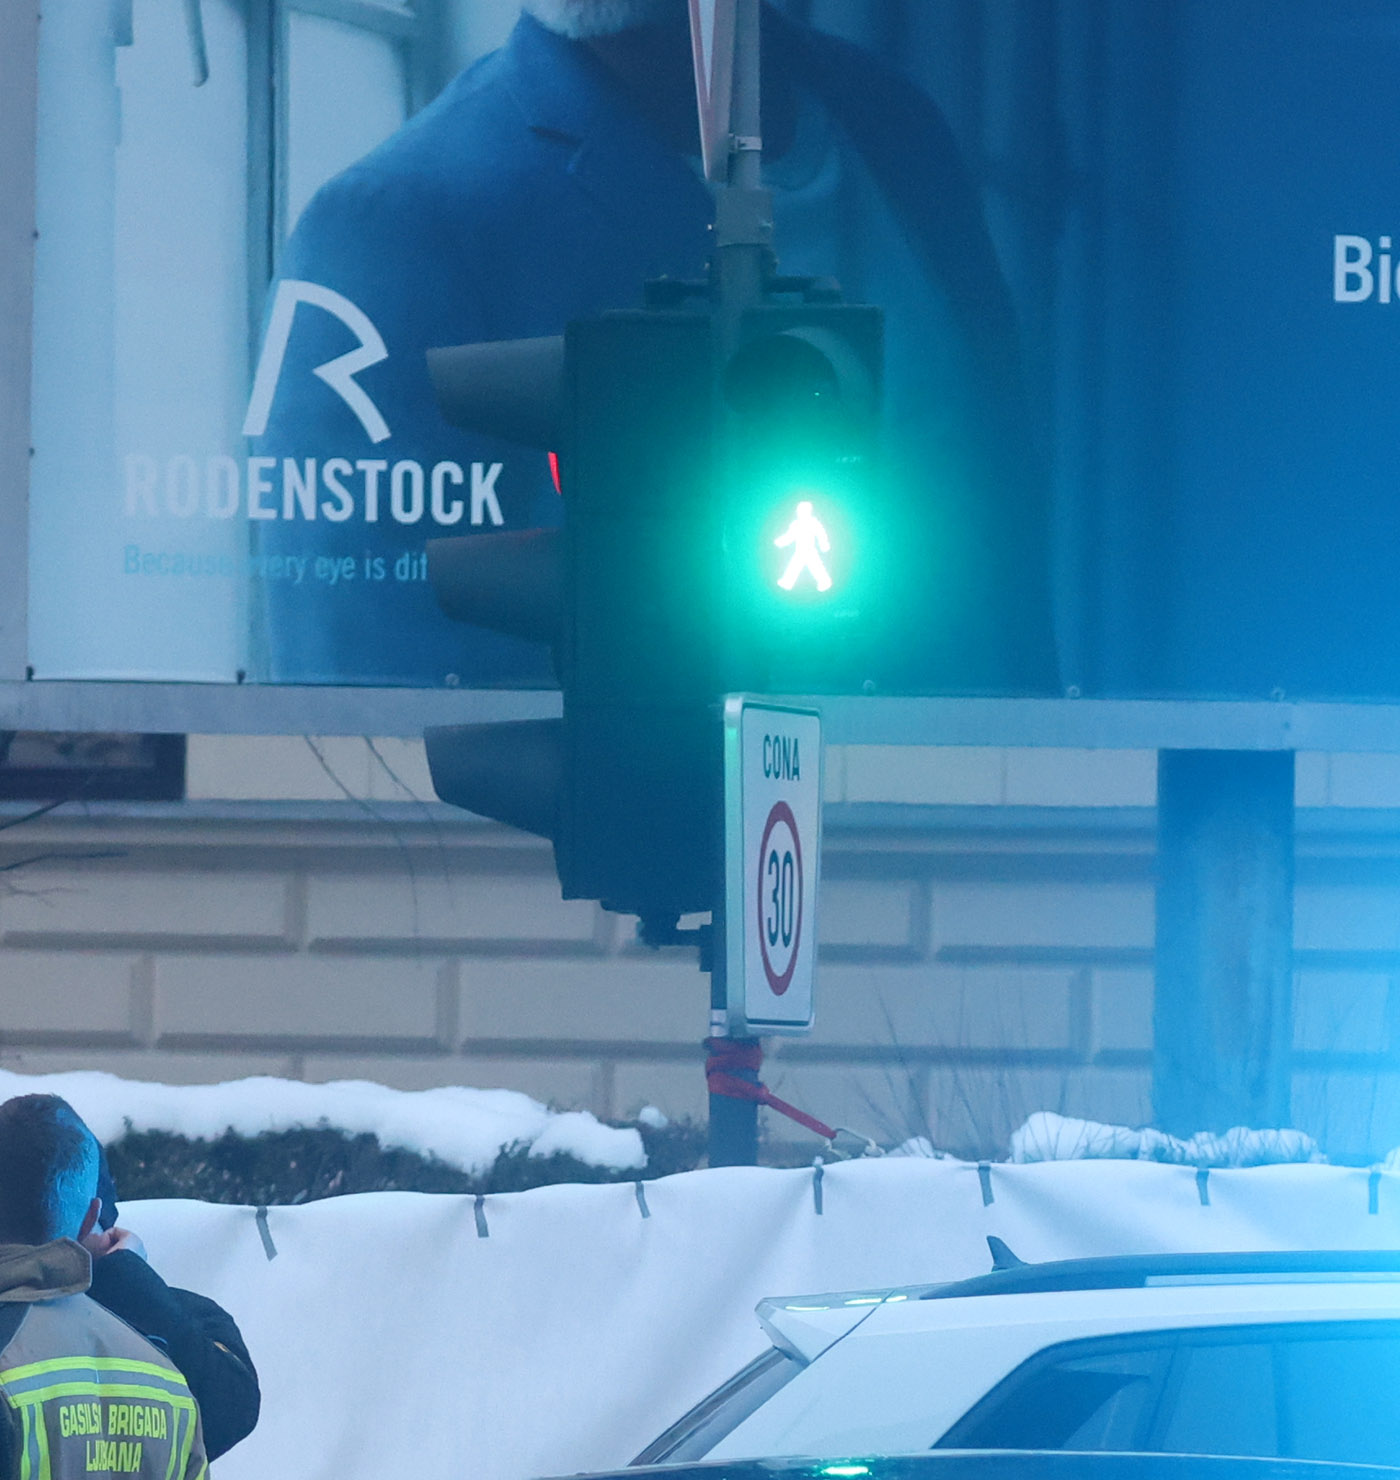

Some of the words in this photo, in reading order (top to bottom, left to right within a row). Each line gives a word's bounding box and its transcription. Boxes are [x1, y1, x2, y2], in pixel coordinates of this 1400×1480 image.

[241, 279, 392, 444] R
[124, 453, 504, 526] RODENSTOCK
[315, 556, 356, 585] eye
[365, 548, 386, 580] is
[762, 733, 801, 781] CONA
[767, 849, 794, 948] 30
[108, 1404, 167, 1440] BRIGADA
